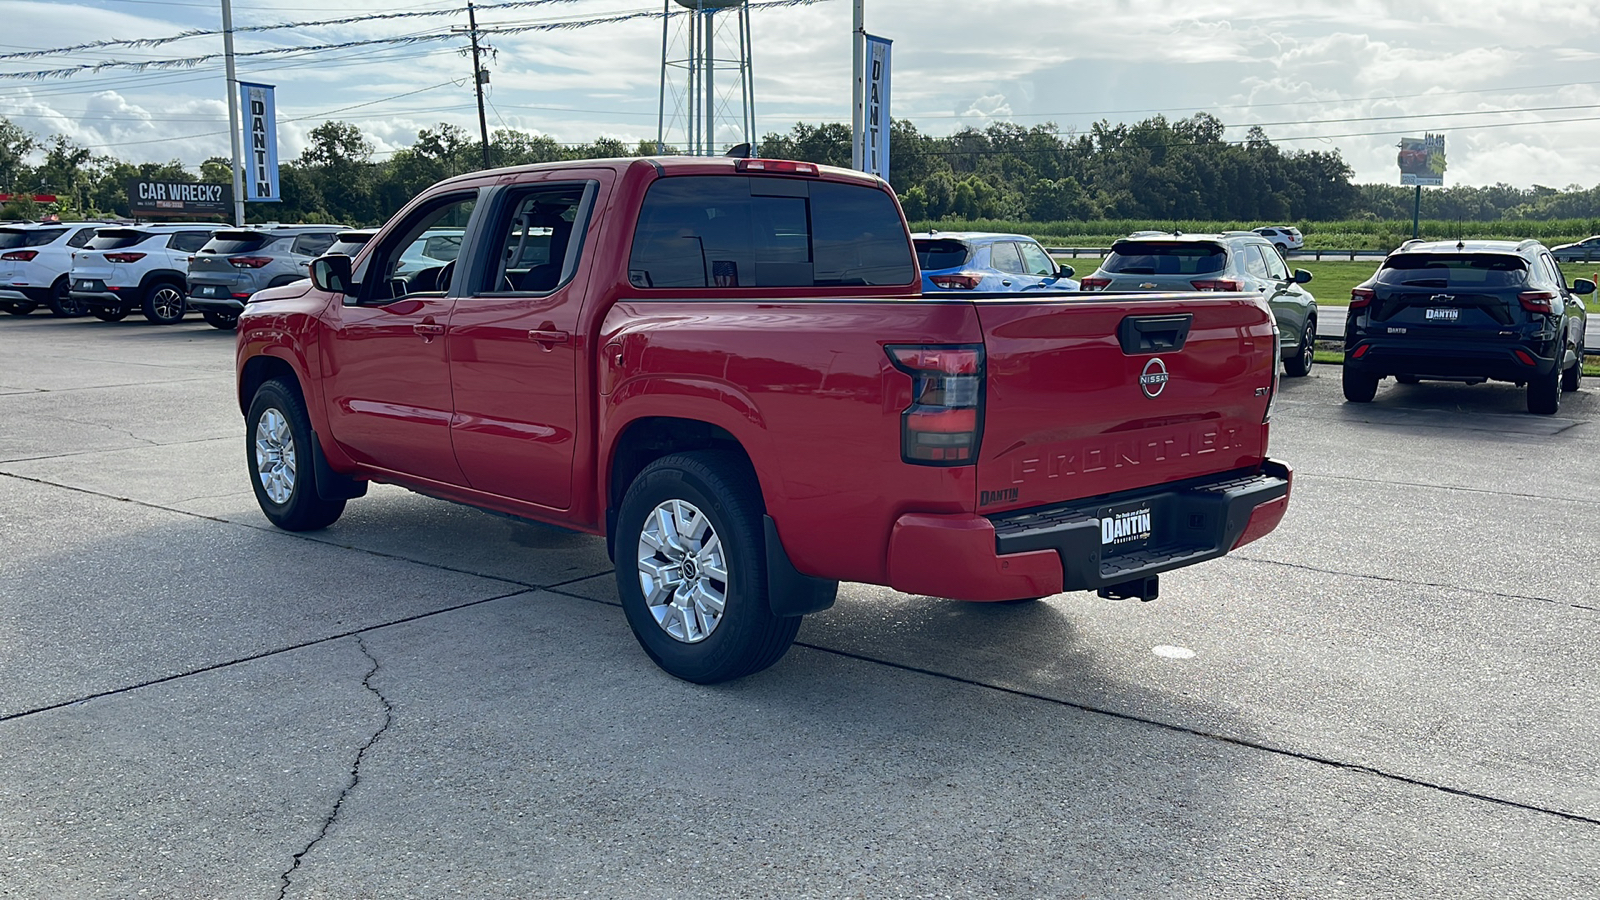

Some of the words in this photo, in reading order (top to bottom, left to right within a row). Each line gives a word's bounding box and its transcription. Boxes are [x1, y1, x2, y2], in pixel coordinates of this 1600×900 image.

[251, 100, 270, 197] DANTIN
[138, 182, 166, 199] CAR
[168, 184, 222, 201] WRECK?
[1425, 309, 1458, 319] DANTIN
[1140, 374, 1169, 384] NISSAN
[1254, 387, 1270, 396] SV
[1011, 428, 1243, 483] FRONTIER
[980, 487, 1019, 507] DANTIN
[1101, 513, 1151, 544] DANTIN
